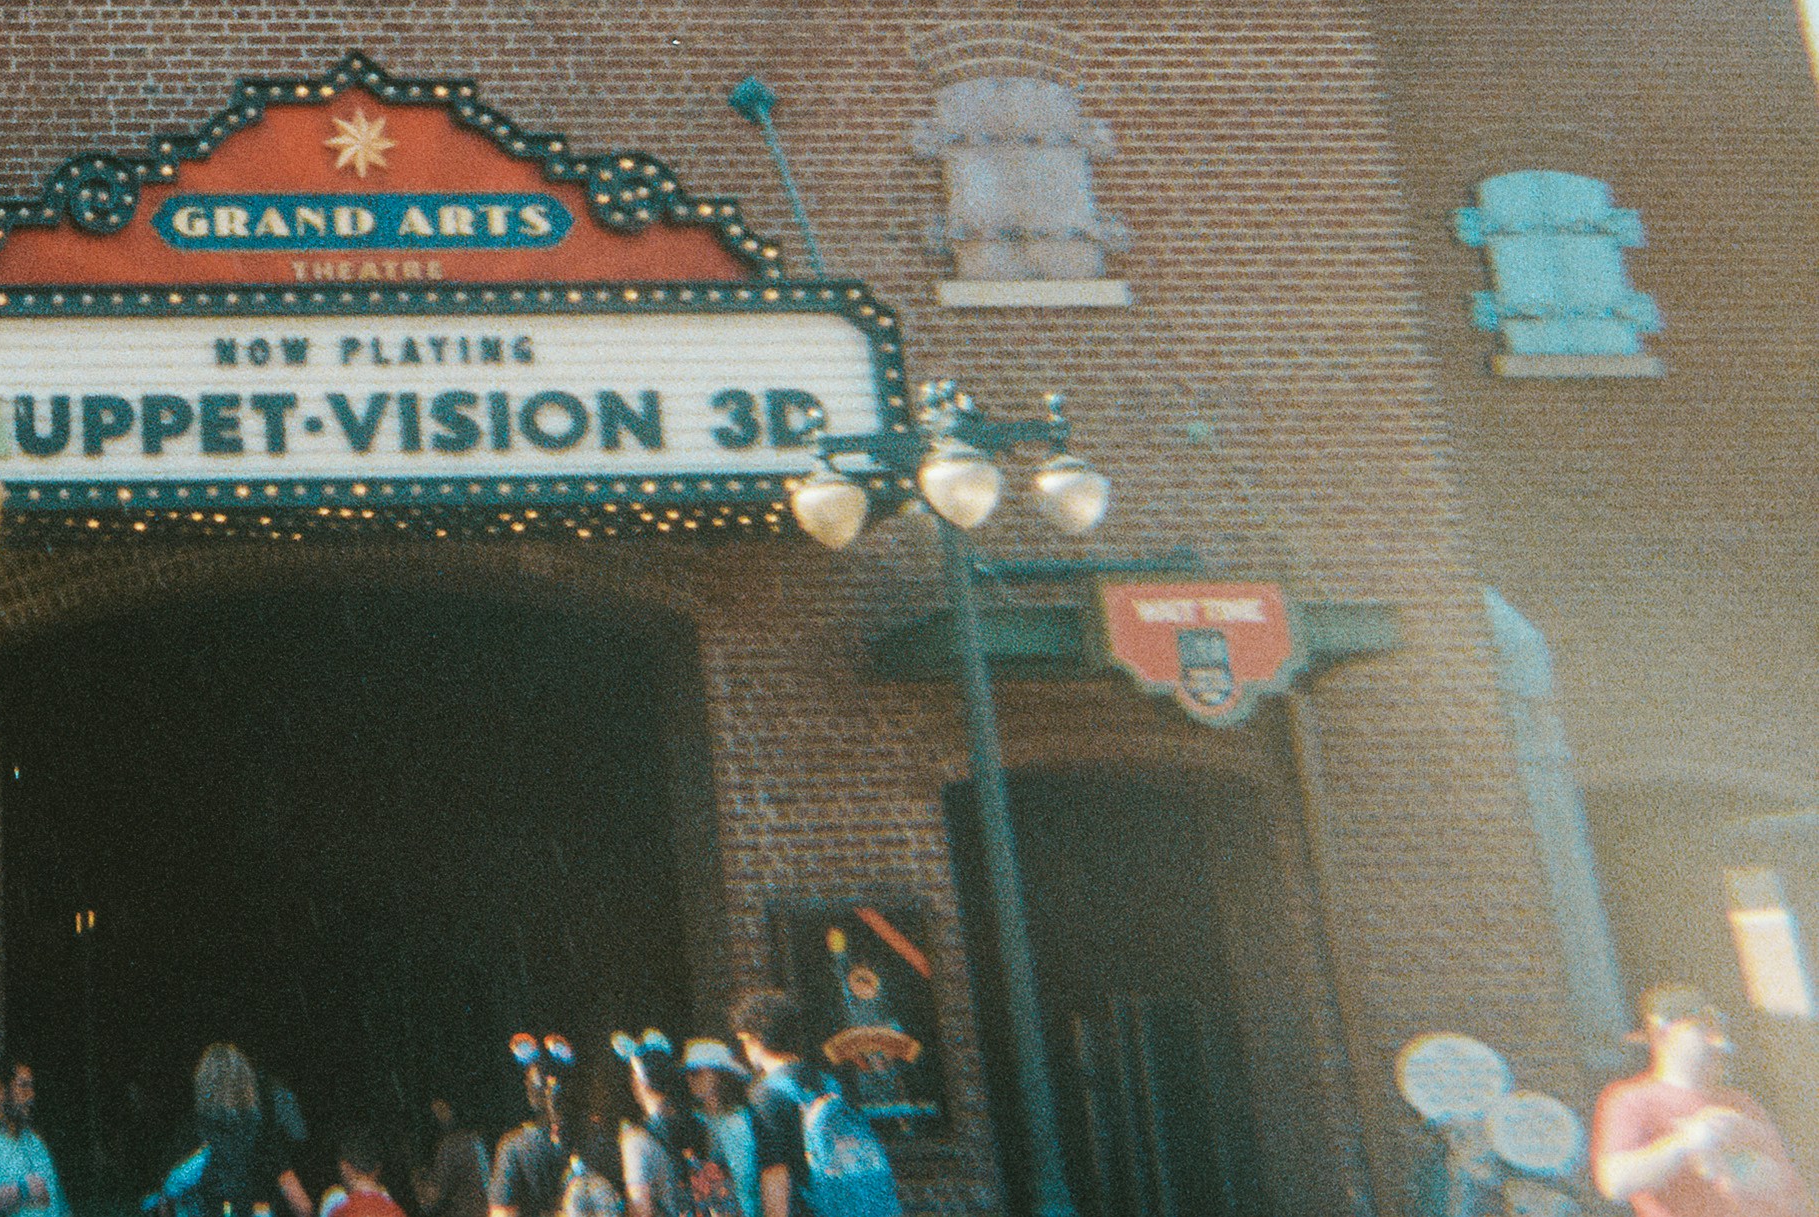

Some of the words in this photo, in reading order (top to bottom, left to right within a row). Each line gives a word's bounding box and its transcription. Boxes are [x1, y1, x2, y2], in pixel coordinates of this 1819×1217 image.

[171, 205, 377, 238] GRAND
[398, 205, 553, 238] ARTS
[290, 258, 444, 281] THEATRE
[213, 335, 310, 367] NOW
[340, 335, 535, 366] PLAYING
[708, 387, 827, 451] 3D
